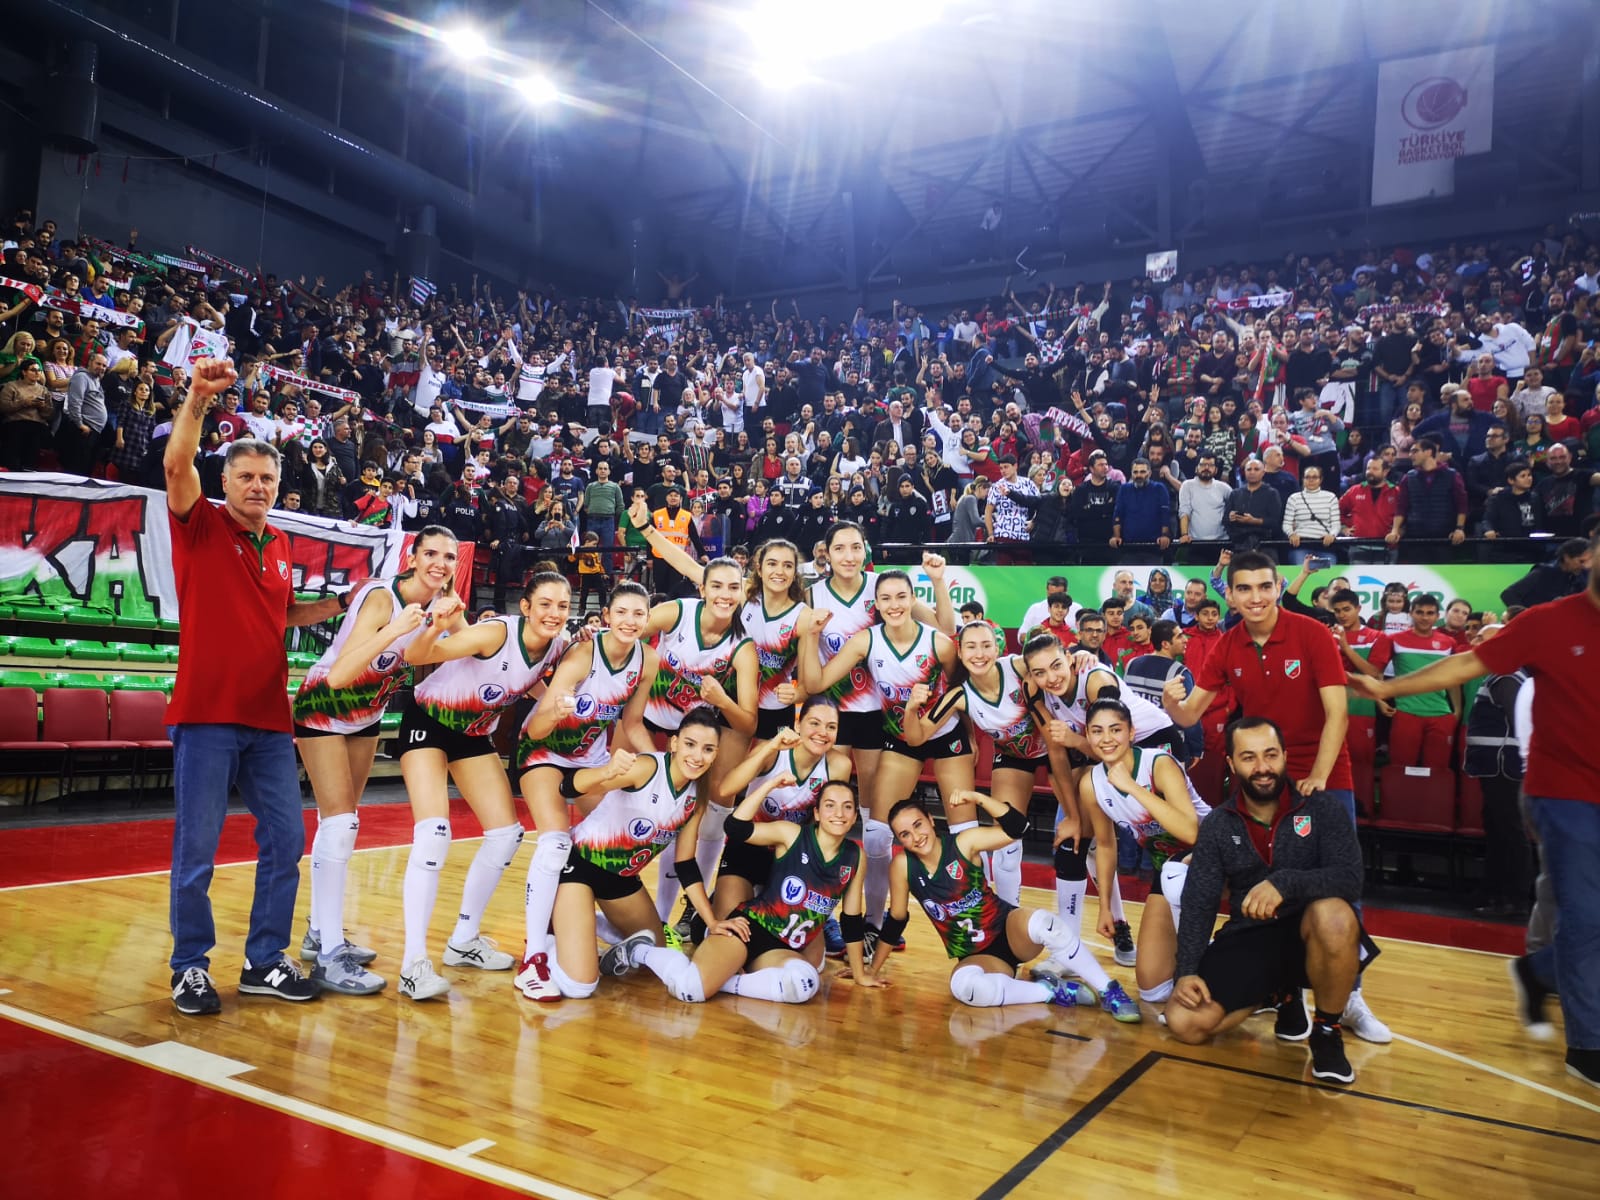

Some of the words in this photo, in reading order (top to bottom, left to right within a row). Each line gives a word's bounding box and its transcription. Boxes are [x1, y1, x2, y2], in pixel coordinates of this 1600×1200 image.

[1399, 131, 1465, 147] TÜRKİYE
[1147, 266, 1176, 279] BLOK
[914, 586, 976, 604] PIAR
[666, 675, 697, 707] 18
[409, 729, 427, 743] 10
[573, 726, 601, 756] 5
[1006, 734, 1041, 759] 12
[620, 849, 652, 876] 9
[779, 913, 815, 949] 16
[956, 918, 985, 942] 3
[264, 968, 288, 988] N
